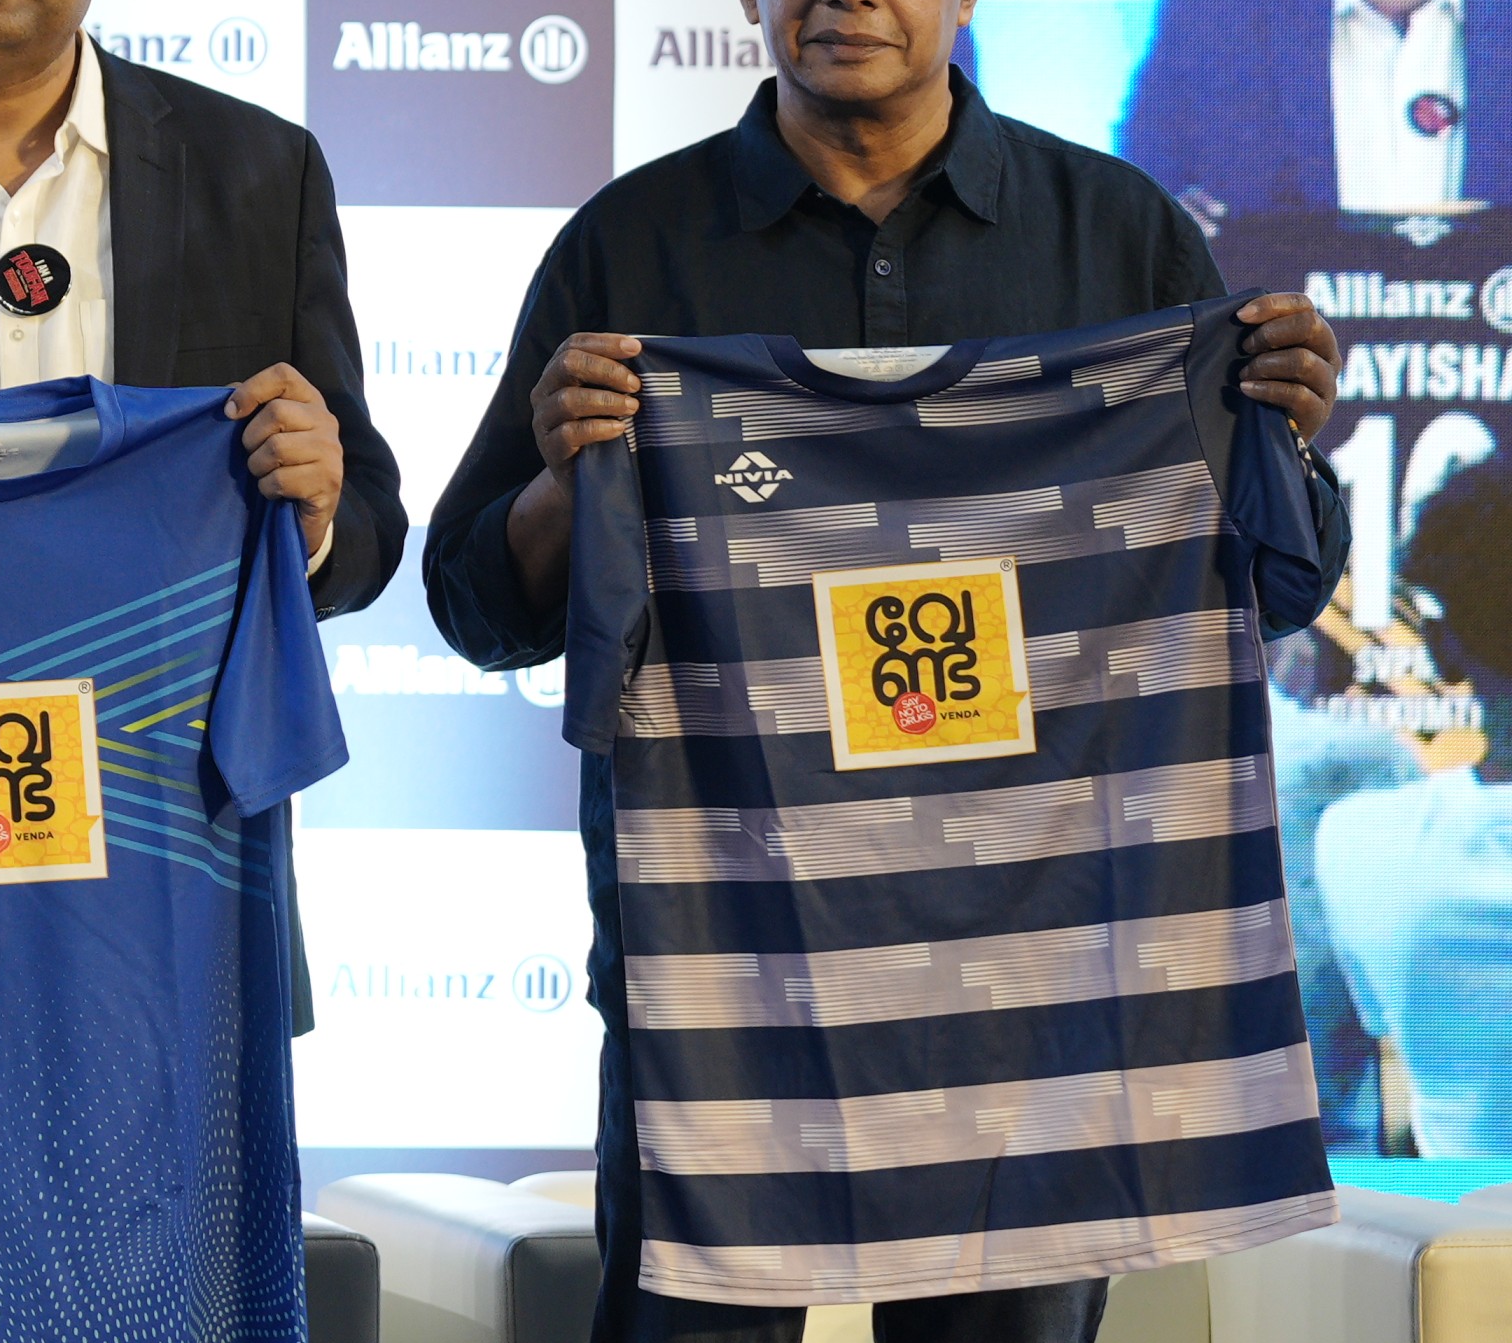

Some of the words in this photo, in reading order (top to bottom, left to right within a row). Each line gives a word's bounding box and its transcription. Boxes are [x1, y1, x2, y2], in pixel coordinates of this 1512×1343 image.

[333, 22, 512, 72] Allianz
[650, 27, 777, 70] Allia
[1304, 271, 1475, 319] Allianz
[375, 340, 503, 376] llianz
[1336, 342, 1512, 401] AYISH
[714, 468, 794, 487] NIVIA
[331, 644, 508, 695] Allianz
[898, 706, 914, 718] NO
[914, 703, 928, 714] TO
[899, 712, 934, 728] DRUGS
[901, 696, 920, 708] SAY
[940, 709, 981, 721] VENDA
[15, 831, 54, 841] VENDA
[330, 963, 495, 1000] Allianz
